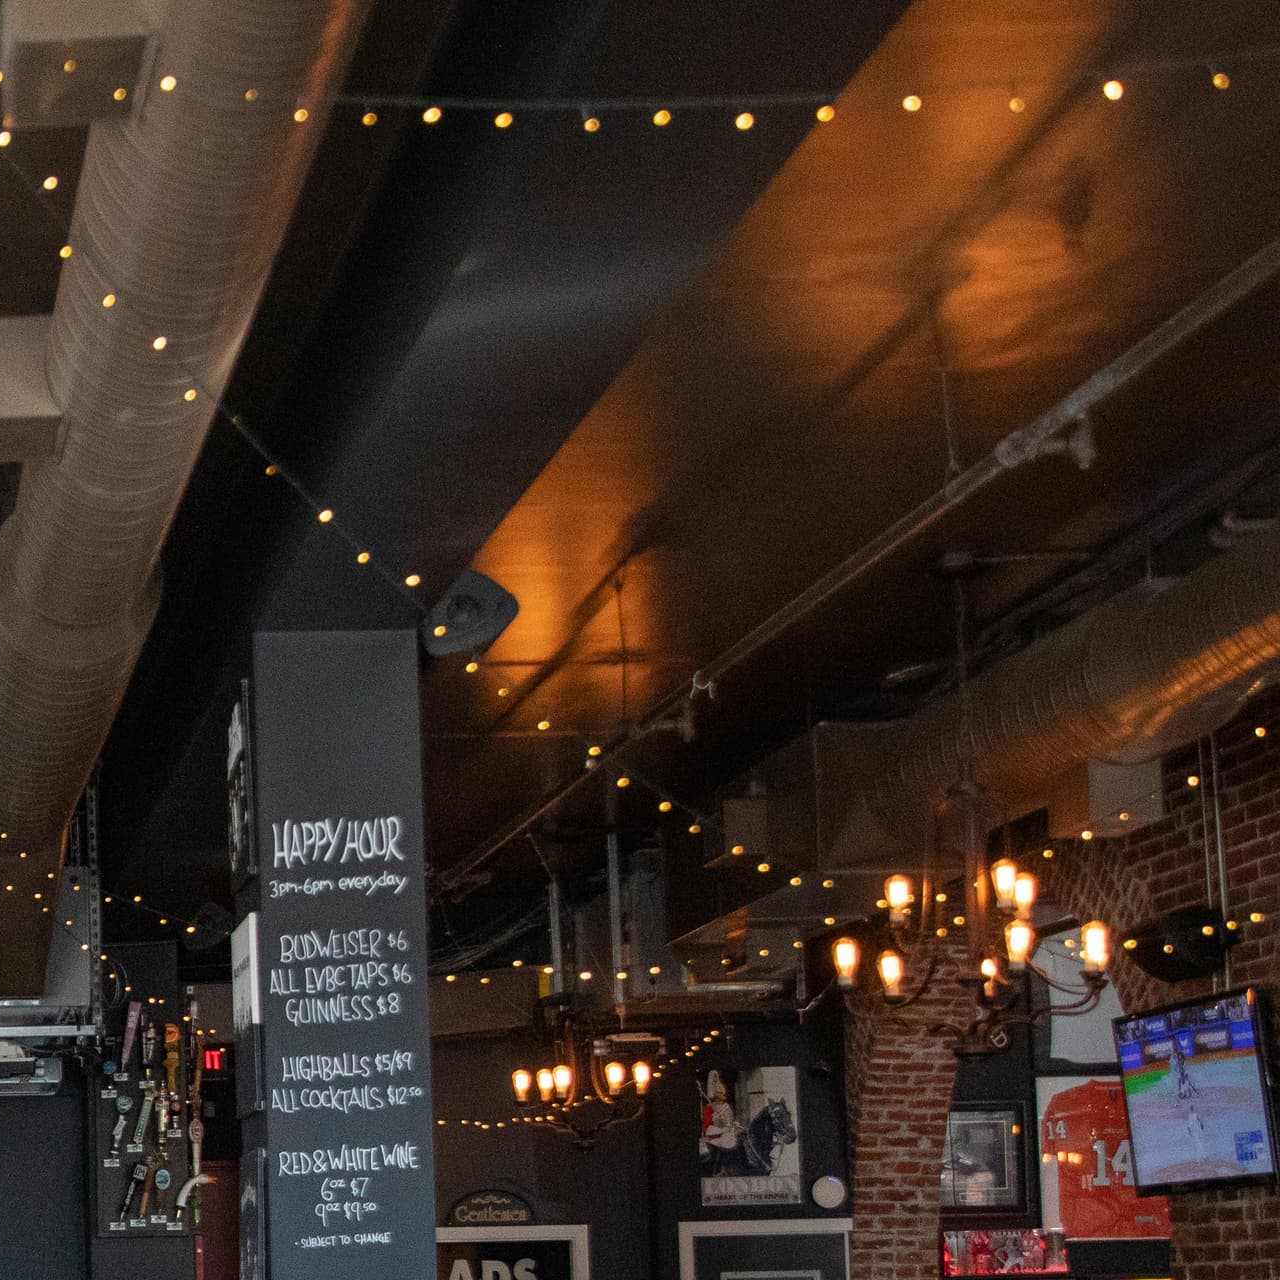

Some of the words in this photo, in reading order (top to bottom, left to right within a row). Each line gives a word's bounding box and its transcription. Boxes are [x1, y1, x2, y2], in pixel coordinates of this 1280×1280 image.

[272, 817, 344, 869] HAPPY
[340, 816, 406, 862] HOUR
[269, 878, 333, 898] 3pm-6pm
[338, 871, 407, 896] everyday
[280, 929, 381, 963] BUDWEISER
[387, 930, 407, 951] $6
[269, 968, 300, 996] ALL
[305, 965, 346, 993] EVBC
[347, 961, 389, 990] TAPS
[392, 963, 412, 984] $6
[286, 994, 375, 1026] GUINNESS
[376, 993, 400, 1016] $8
[282, 1053, 370, 1082] HIGHBALLS
[374, 1050, 412, 1076] $5/$9
[271, 1088, 300, 1113] ALL
[300, 1085, 384, 1114] COCKTAILS
[1047, 1121, 1066, 1139] 14
[381, 1142, 419, 1169] WINE
[1093, 1139, 1135, 1186] 14
[351, 1178, 369, 1197] $7
[301, 1235, 336, 1248] SUBJECT
[340, 1235, 351, 1244] TO
[354, 1232, 390, 1245] CHANGE
